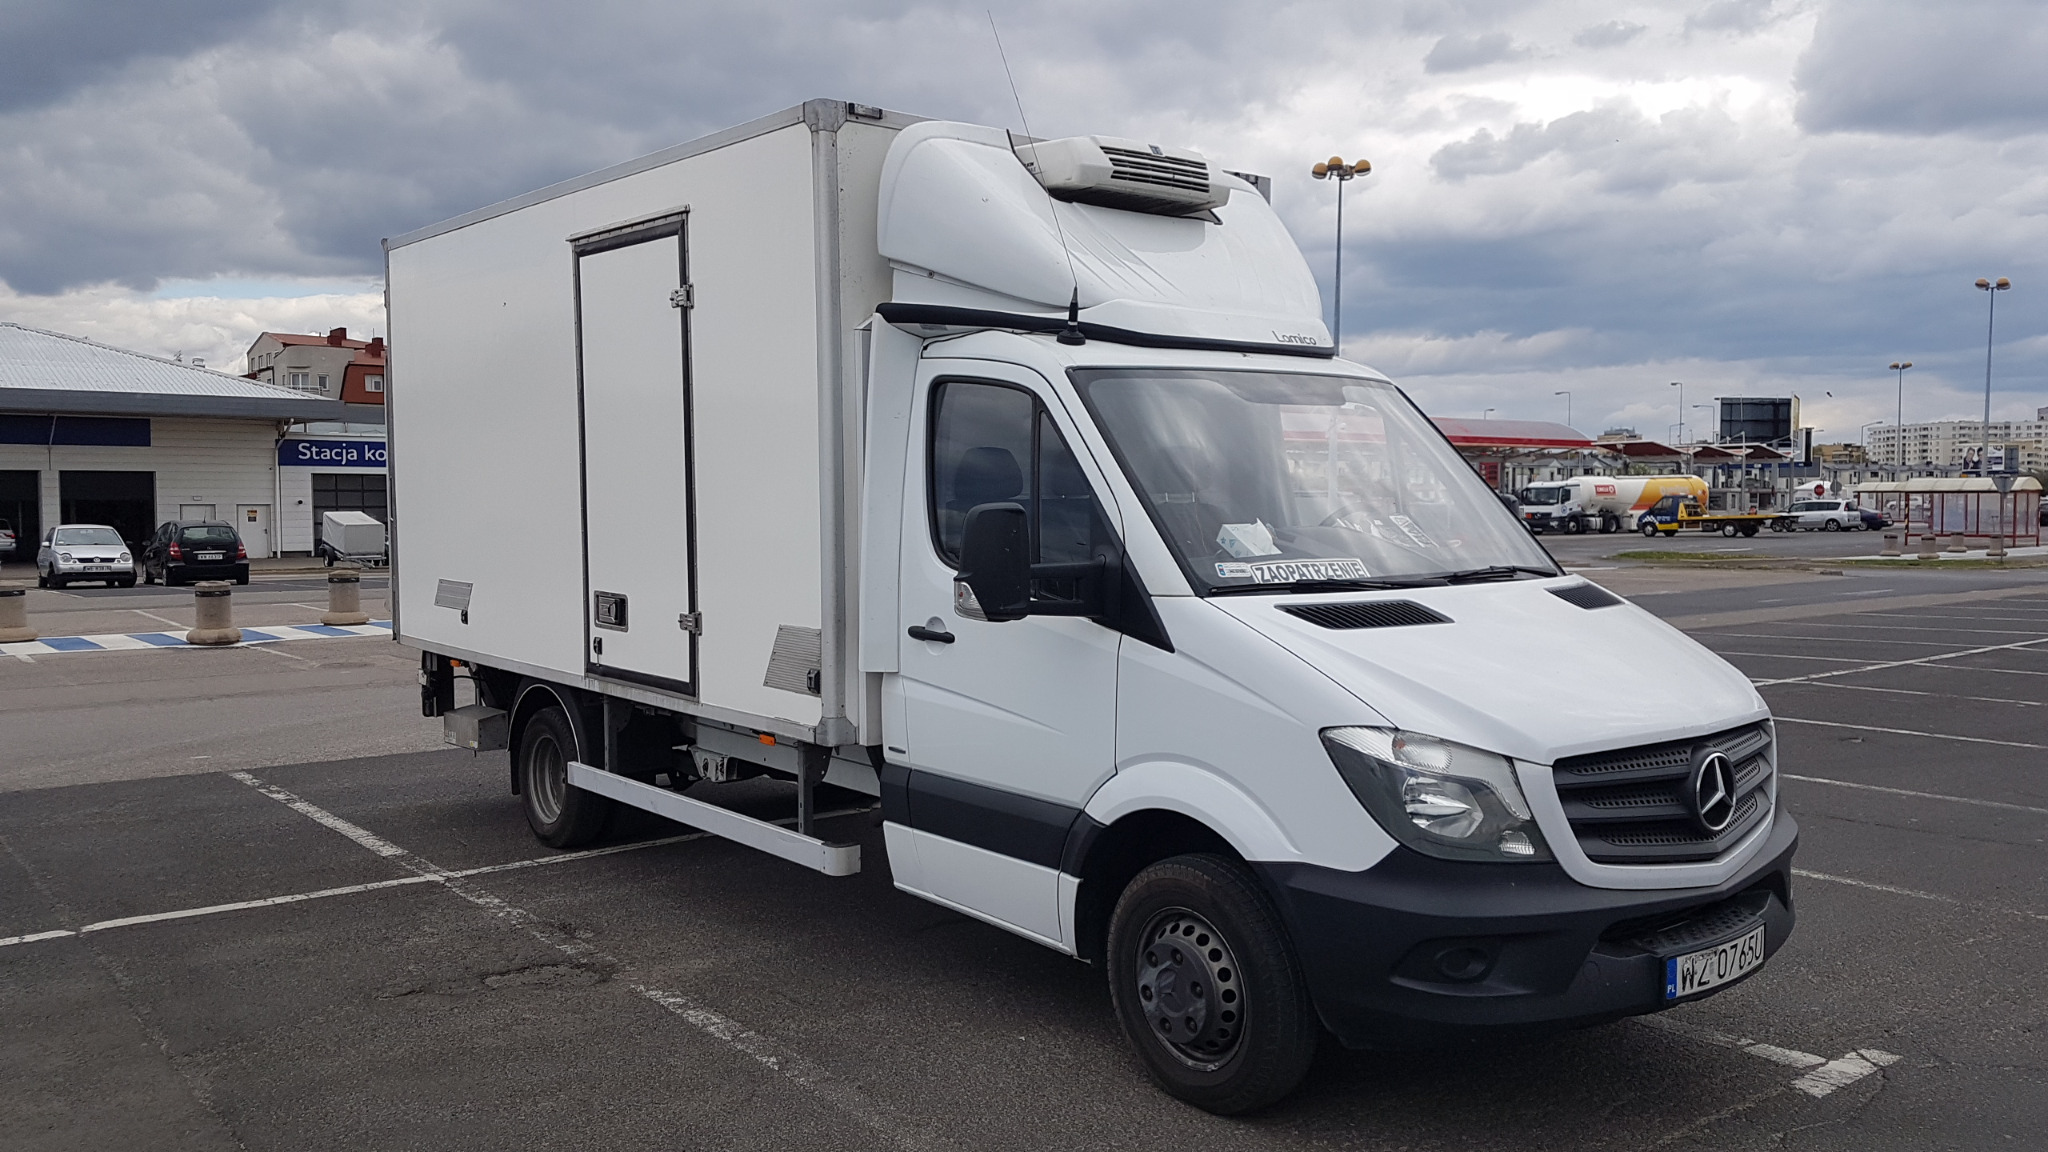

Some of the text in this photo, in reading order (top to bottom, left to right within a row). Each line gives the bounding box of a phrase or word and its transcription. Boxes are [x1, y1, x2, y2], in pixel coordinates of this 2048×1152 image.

[298, 443, 357, 465] Stacja
[1255, 562, 1365, 584] ZAOPATRZENIE
[1718, 930, 1763, 980] 0765U
[1667, 984, 1676, 994] PL
